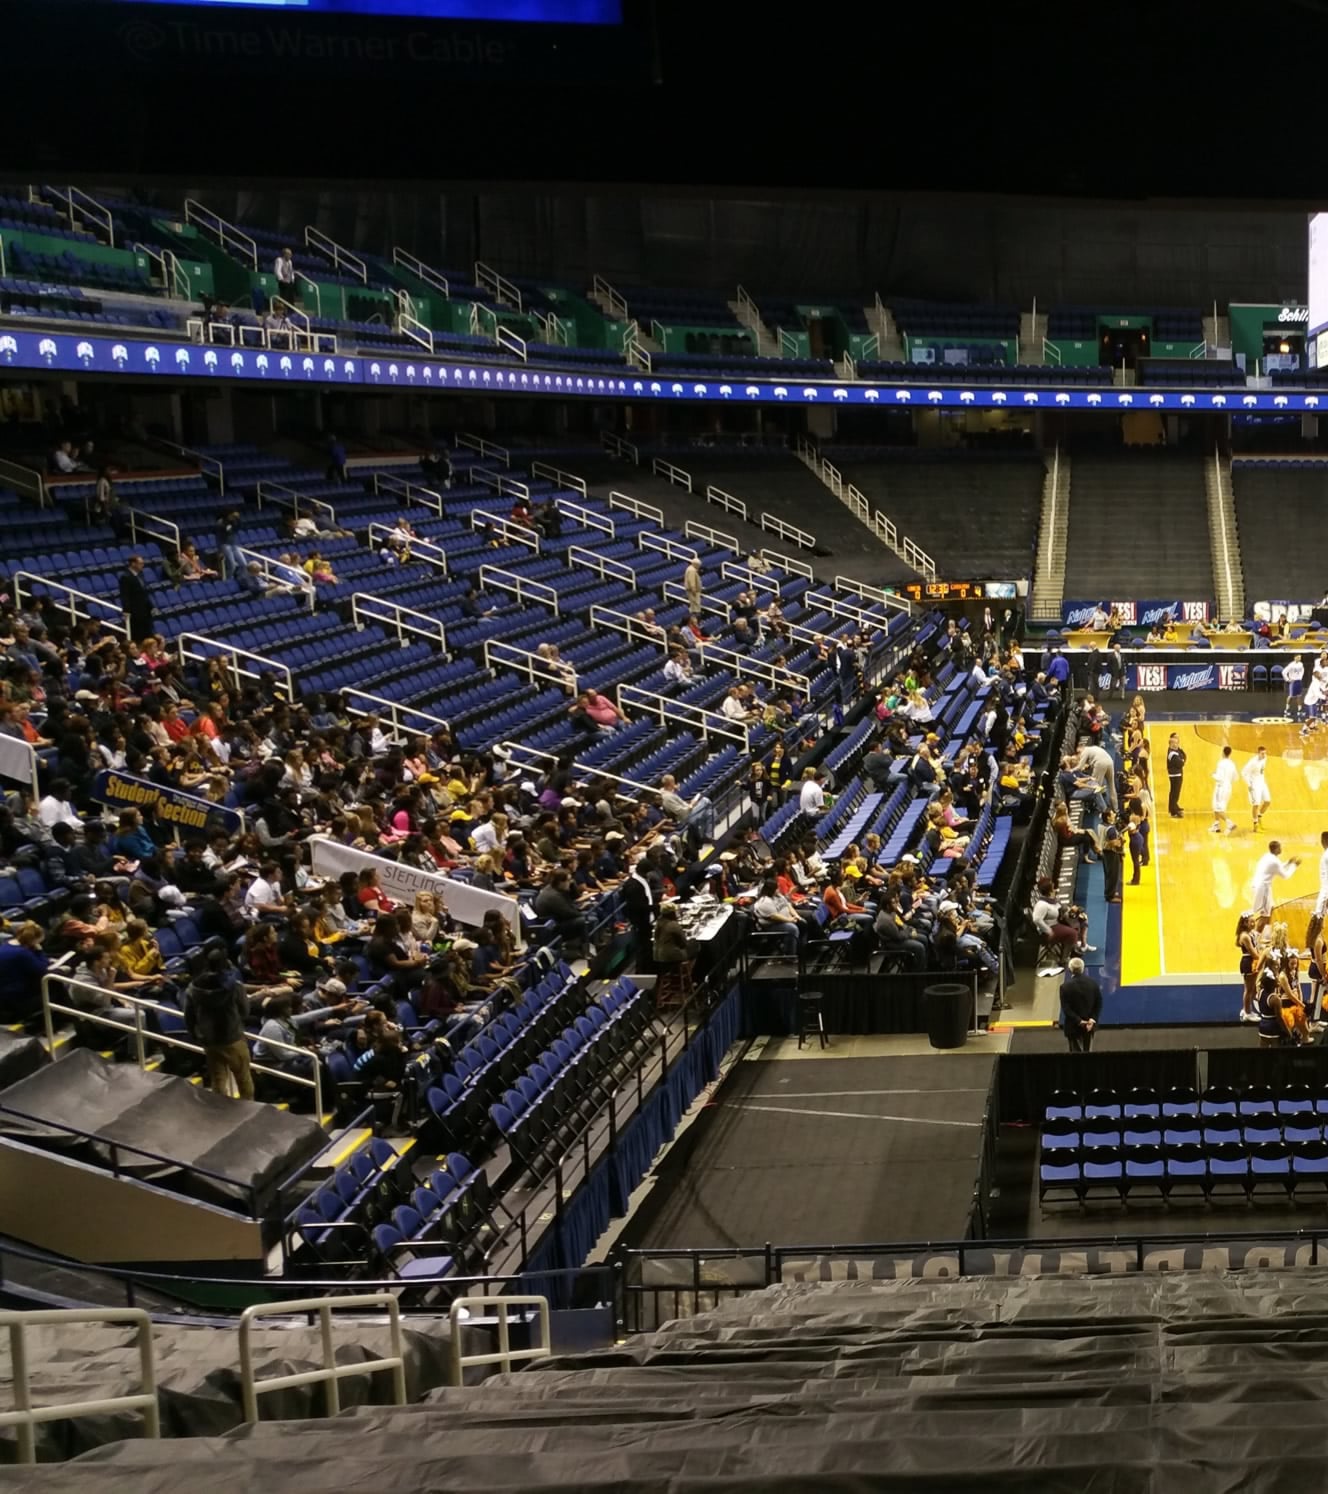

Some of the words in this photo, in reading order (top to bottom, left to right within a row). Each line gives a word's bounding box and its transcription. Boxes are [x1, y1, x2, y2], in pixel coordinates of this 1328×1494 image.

[167, 21, 262, 55] Time
[265, 24, 400, 60] Warner
[407, 31, 505, 64] Cable
[1183, 602, 1206, 620] YES!
[1138, 666, 1165, 686] YES!
[105, 775, 161, 804] Student
[157, 795, 208, 828] Section
